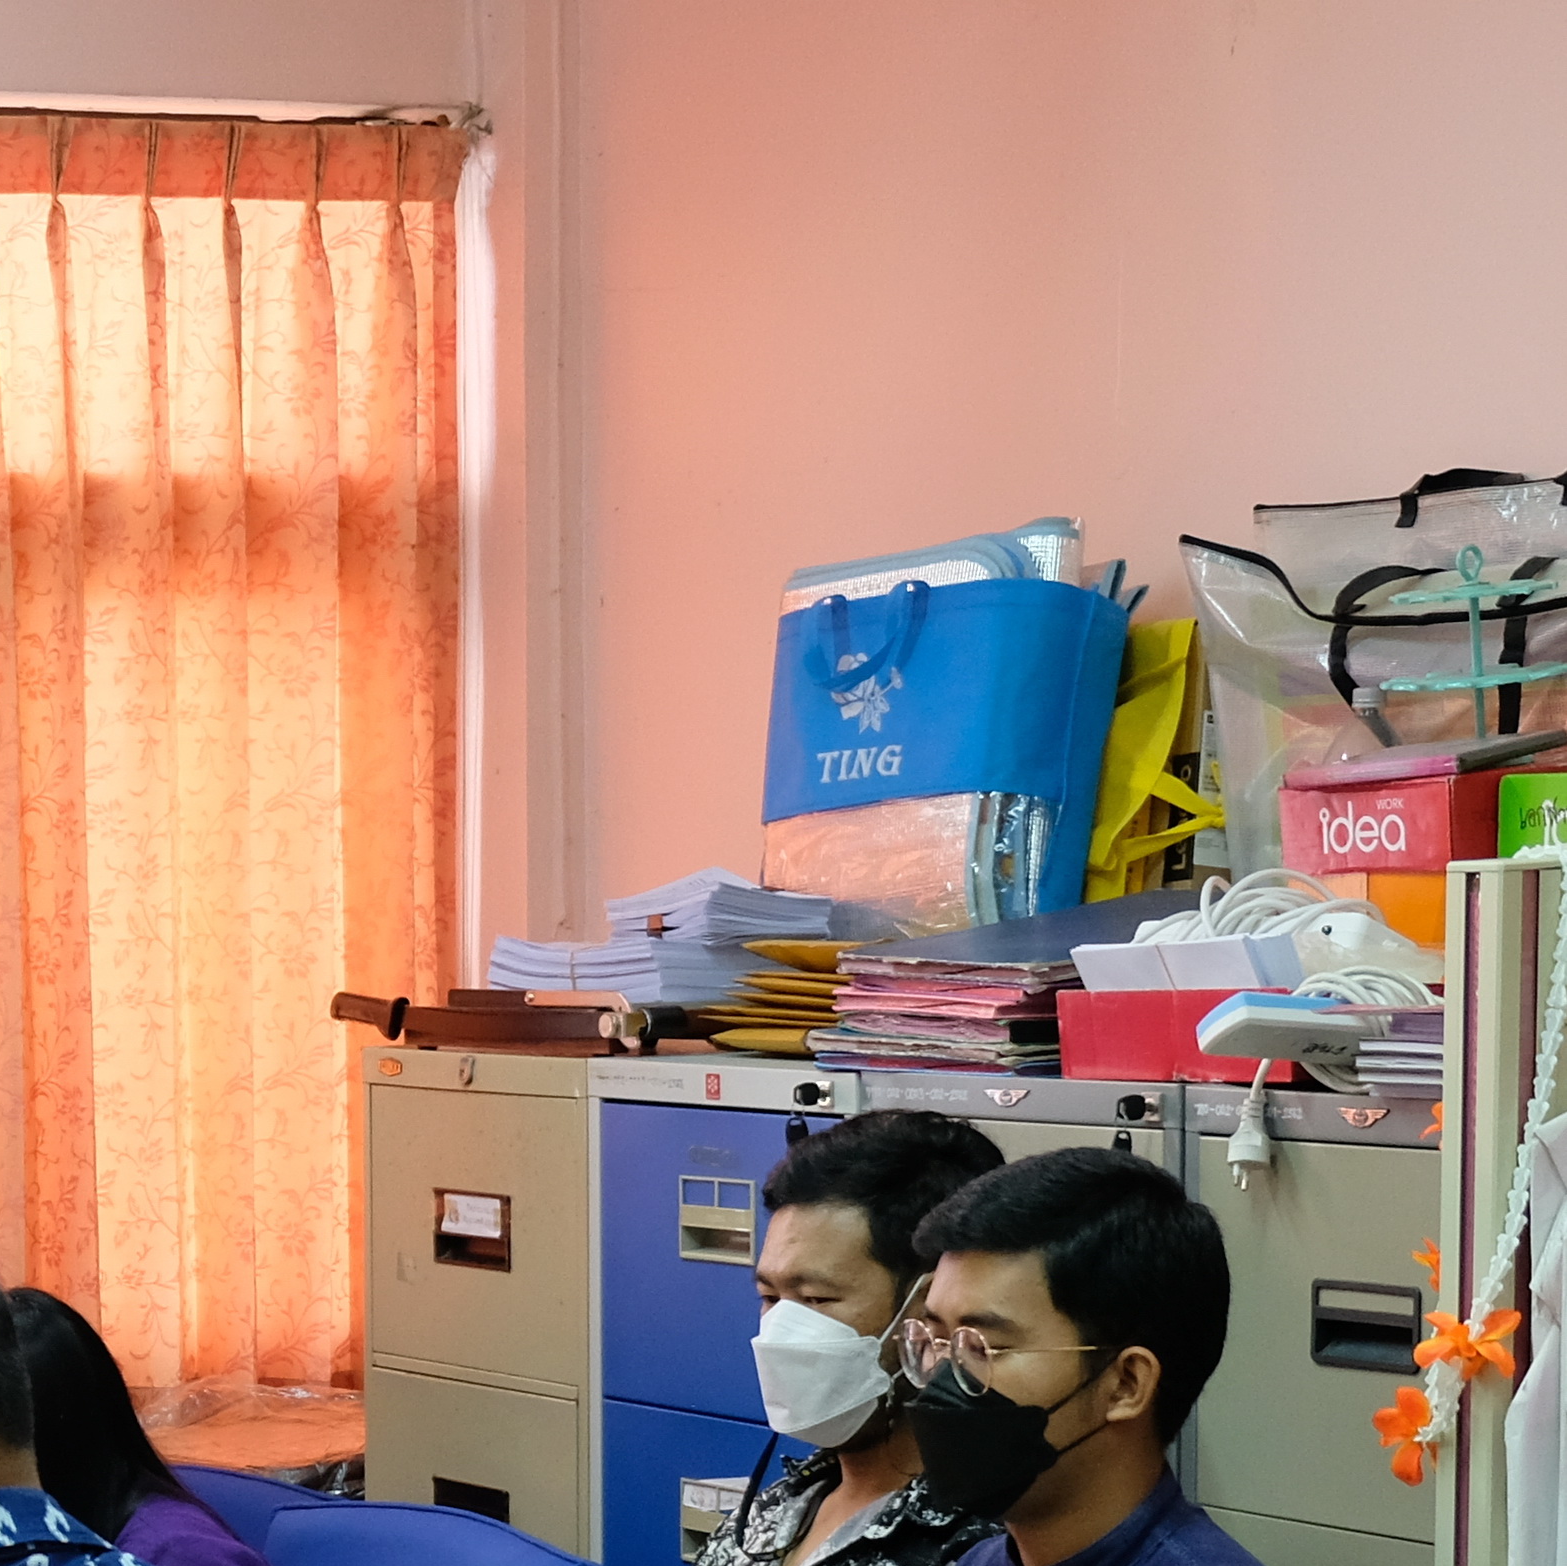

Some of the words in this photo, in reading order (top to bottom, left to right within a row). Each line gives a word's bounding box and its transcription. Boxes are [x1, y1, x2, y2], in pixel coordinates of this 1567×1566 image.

[816, 744, 903, 784] TING
[1376, 798, 1404, 810] WORK
[1319, 801, 1407, 854] idea
